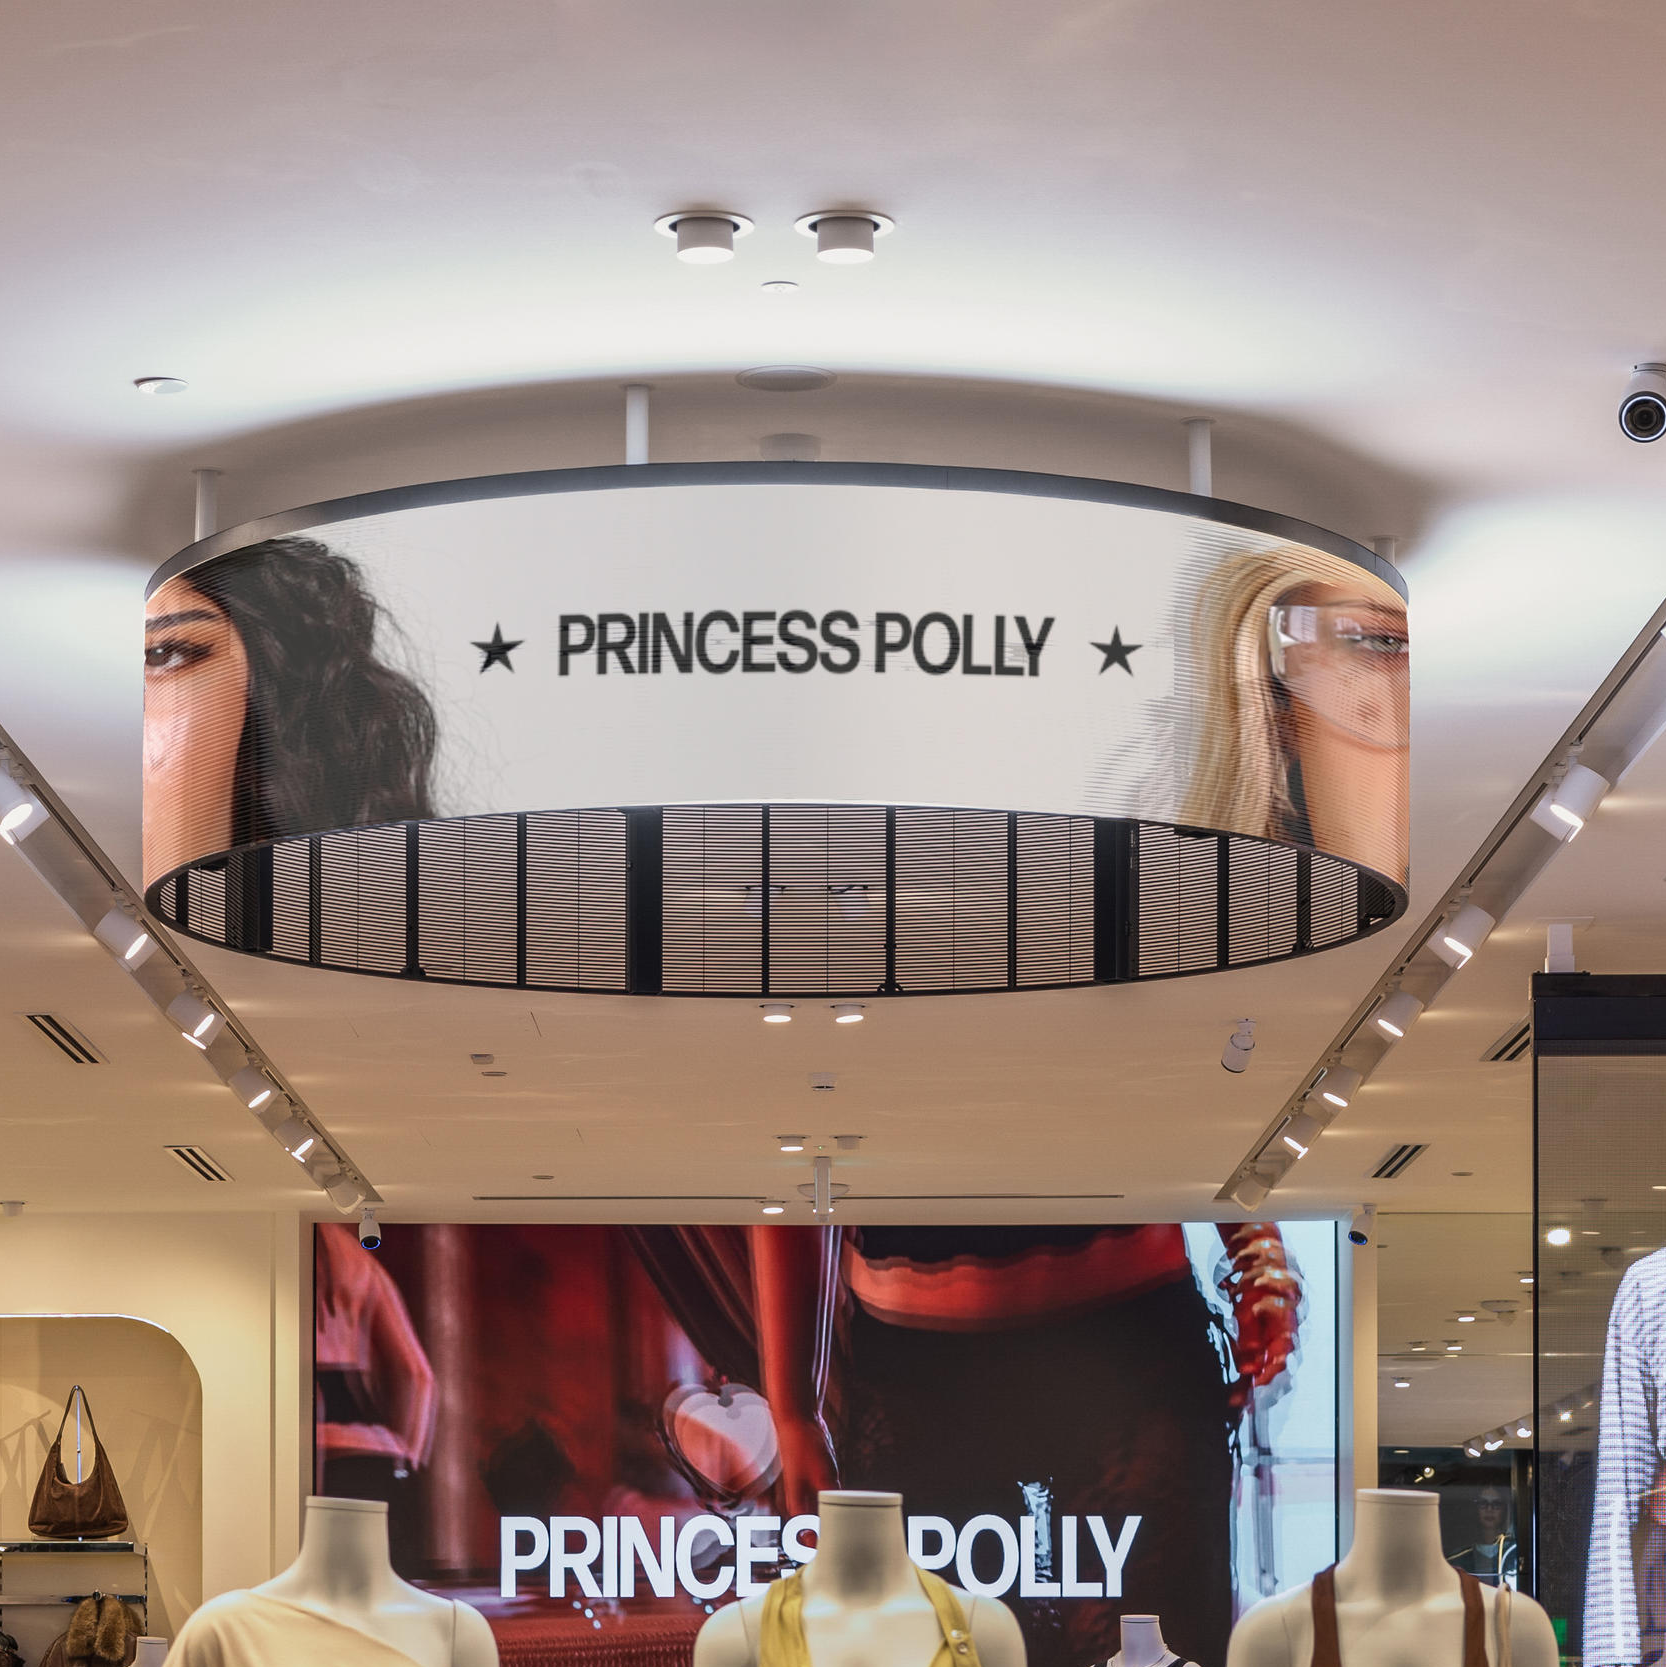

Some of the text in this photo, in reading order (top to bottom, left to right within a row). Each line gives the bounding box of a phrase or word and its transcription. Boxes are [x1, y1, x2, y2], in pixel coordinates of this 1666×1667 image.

[558, 610, 1055, 677] PRINCESS POLLY
[500, 1514, 1143, 1600] PRINCES POLLY
